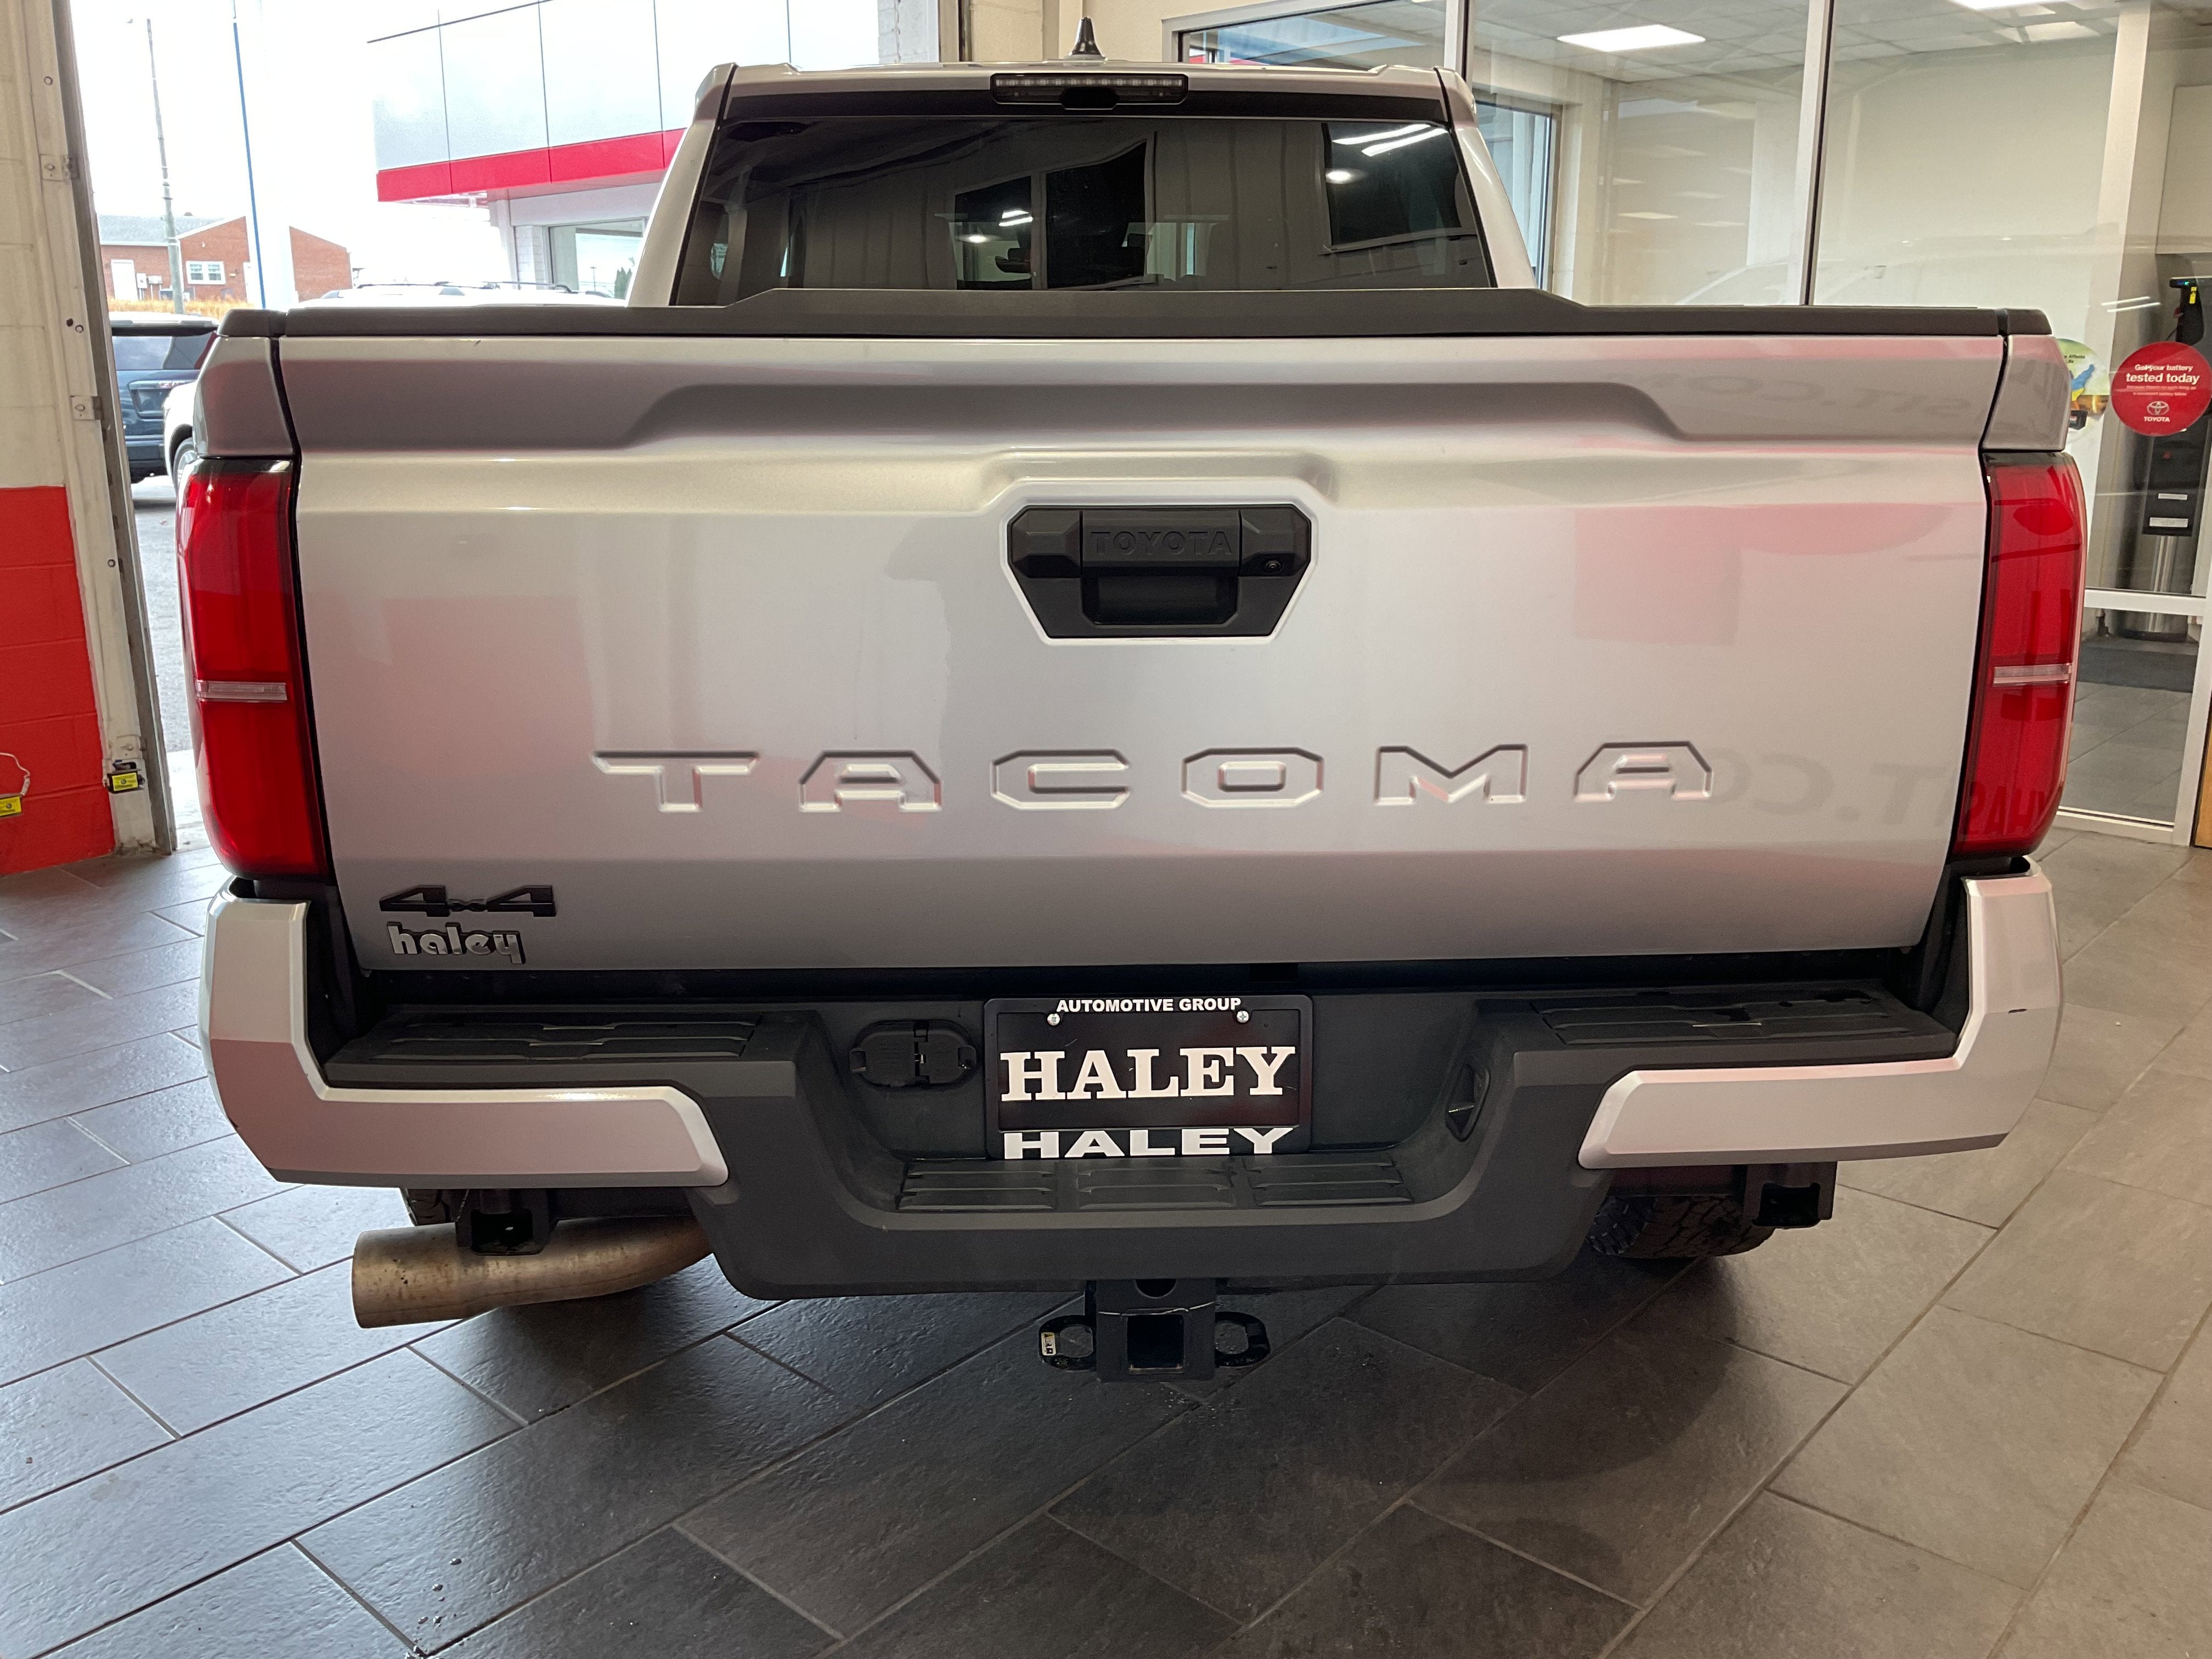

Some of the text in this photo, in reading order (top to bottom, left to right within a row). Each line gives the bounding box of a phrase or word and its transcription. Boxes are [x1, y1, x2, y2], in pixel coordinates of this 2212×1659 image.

[2126, 373, 2200, 385] tested today
[1090, 531, 1233, 556] TOYOTA
[592, 741, 1713, 812] TACOMA
[387, 922, 526, 964] haley
[1057, 997, 1242, 1013] AUTOMOTIVE GROUP
[1000, 1046, 1296, 1101] HALEY
[1003, 1127, 1294, 1160] HALEY
